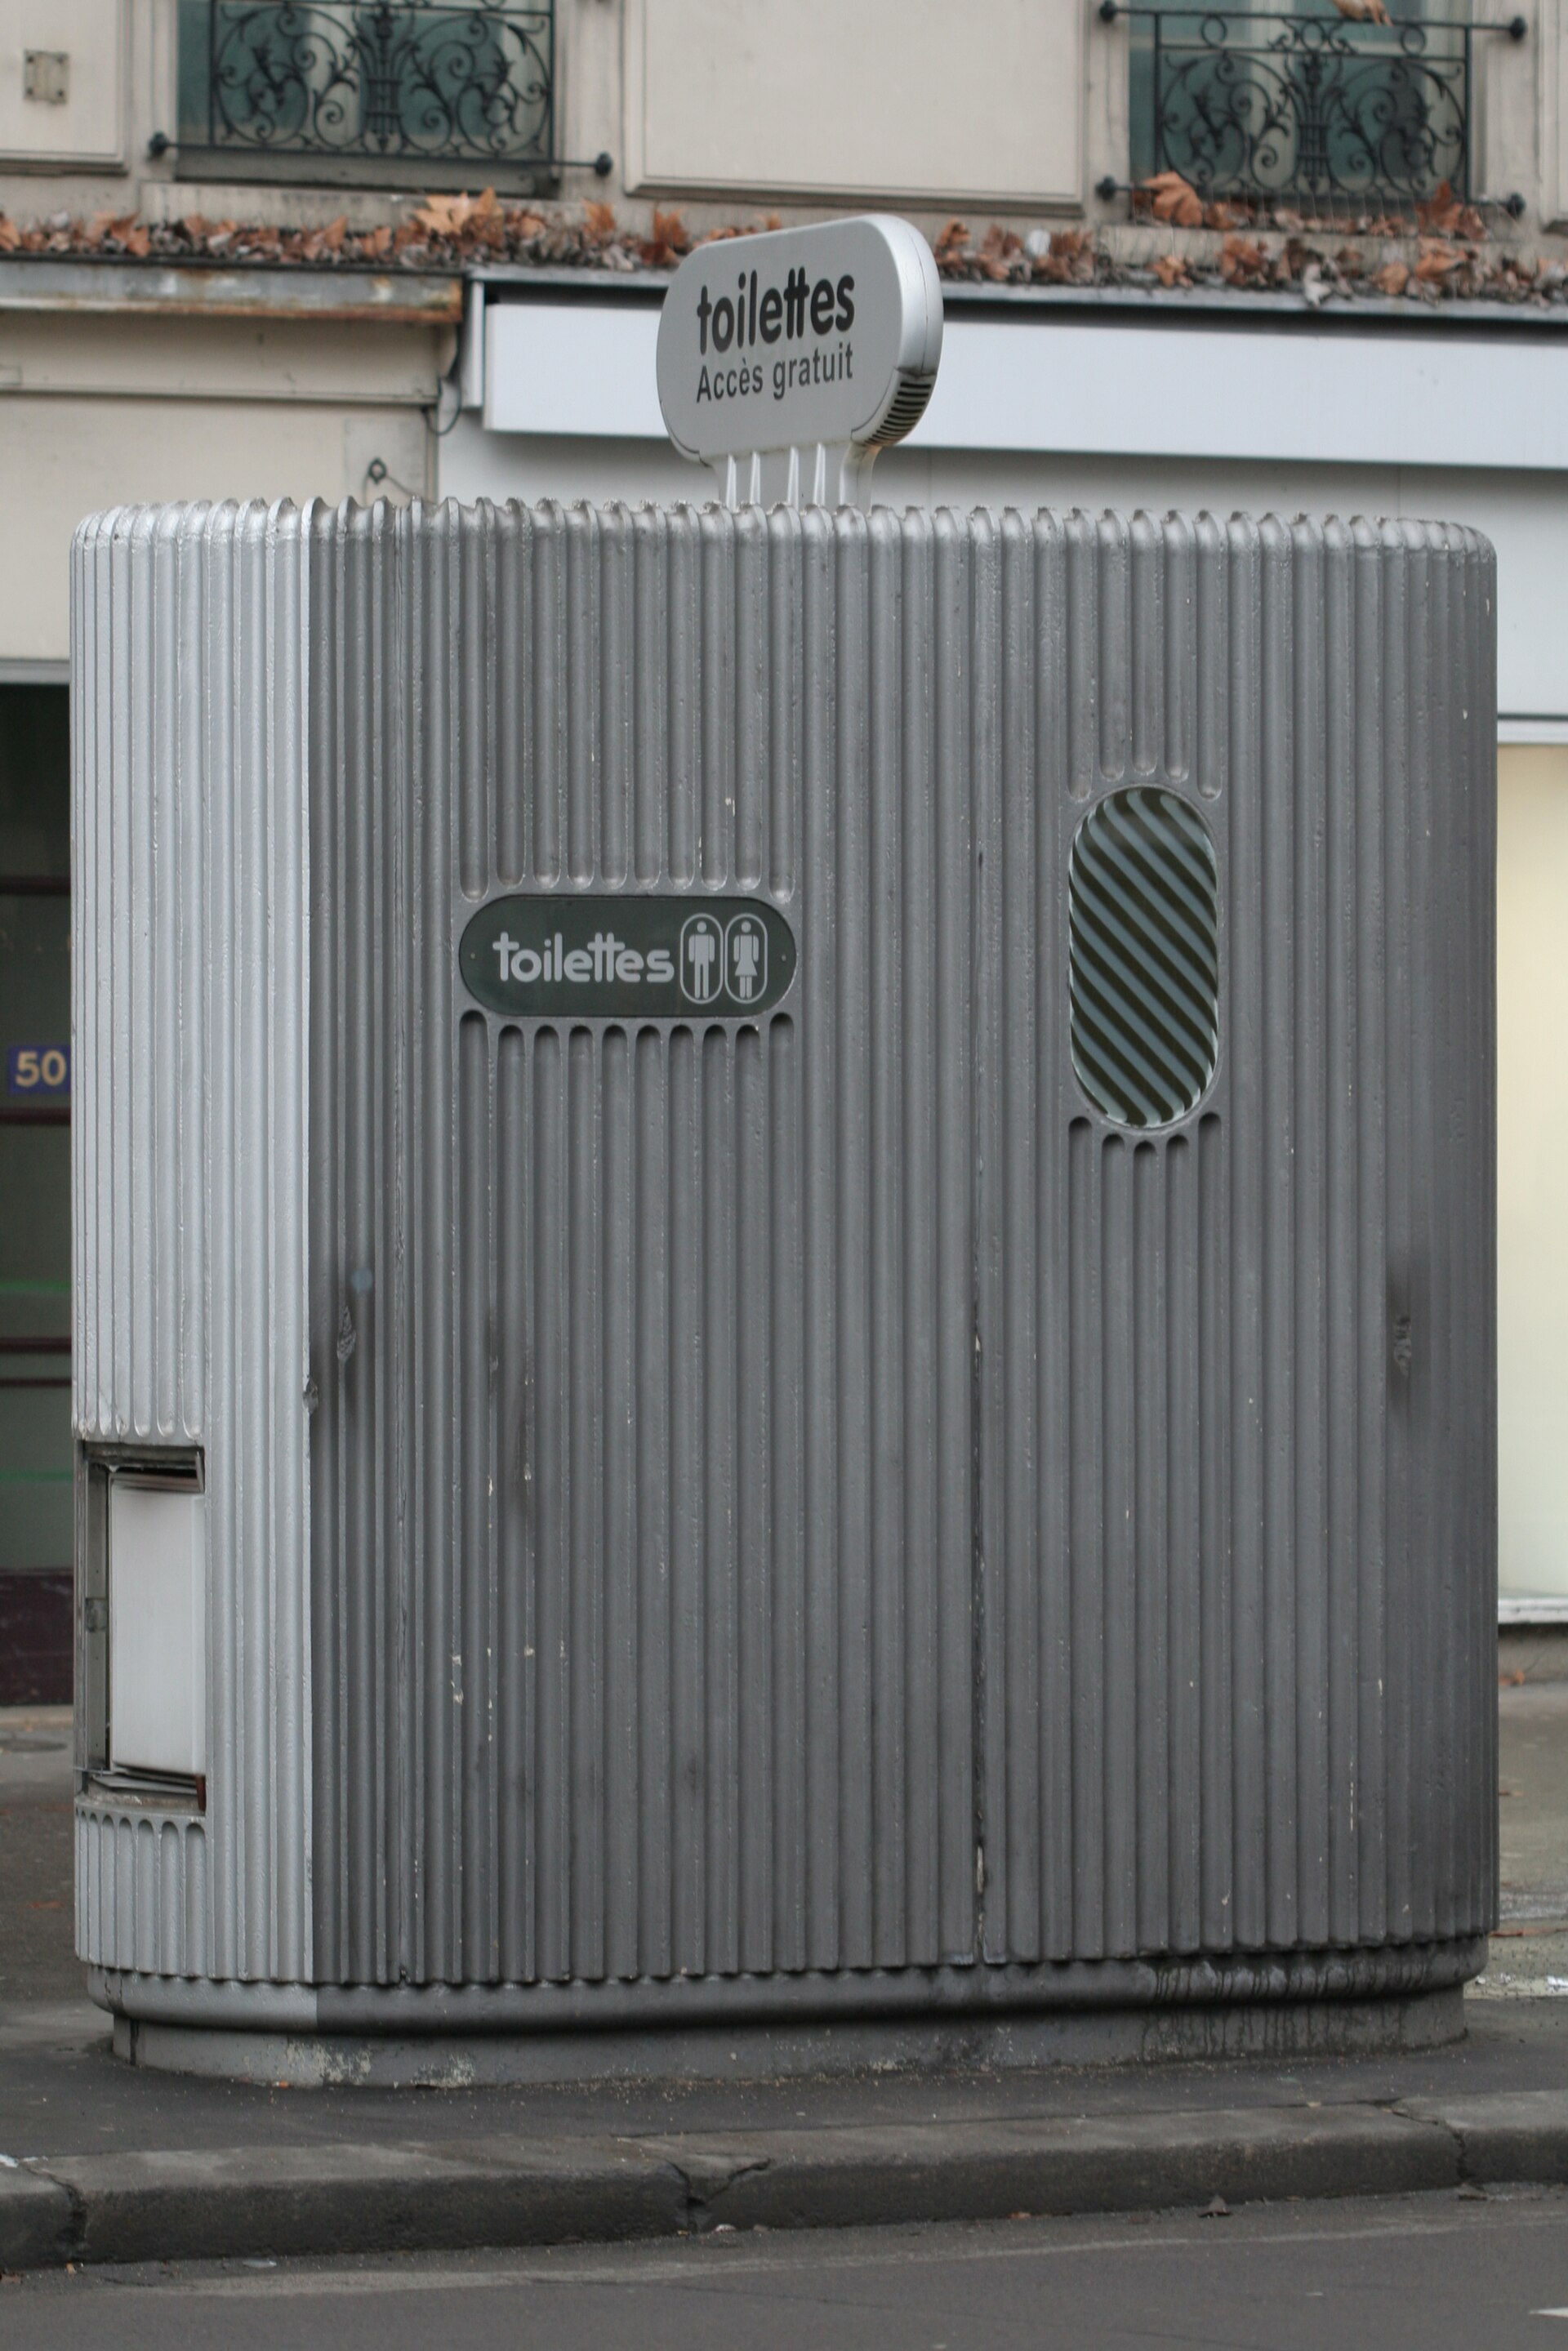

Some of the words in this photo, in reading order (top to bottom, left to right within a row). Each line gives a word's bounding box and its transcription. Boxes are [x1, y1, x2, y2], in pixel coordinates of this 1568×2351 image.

[697, 266, 854, 355] toilettes
[697, 358, 764, 403] Accès
[773, 341, 853, 400] gratuit
[492, 931, 675, 983] toilettes
[15, 1049, 67, 1088] 50
